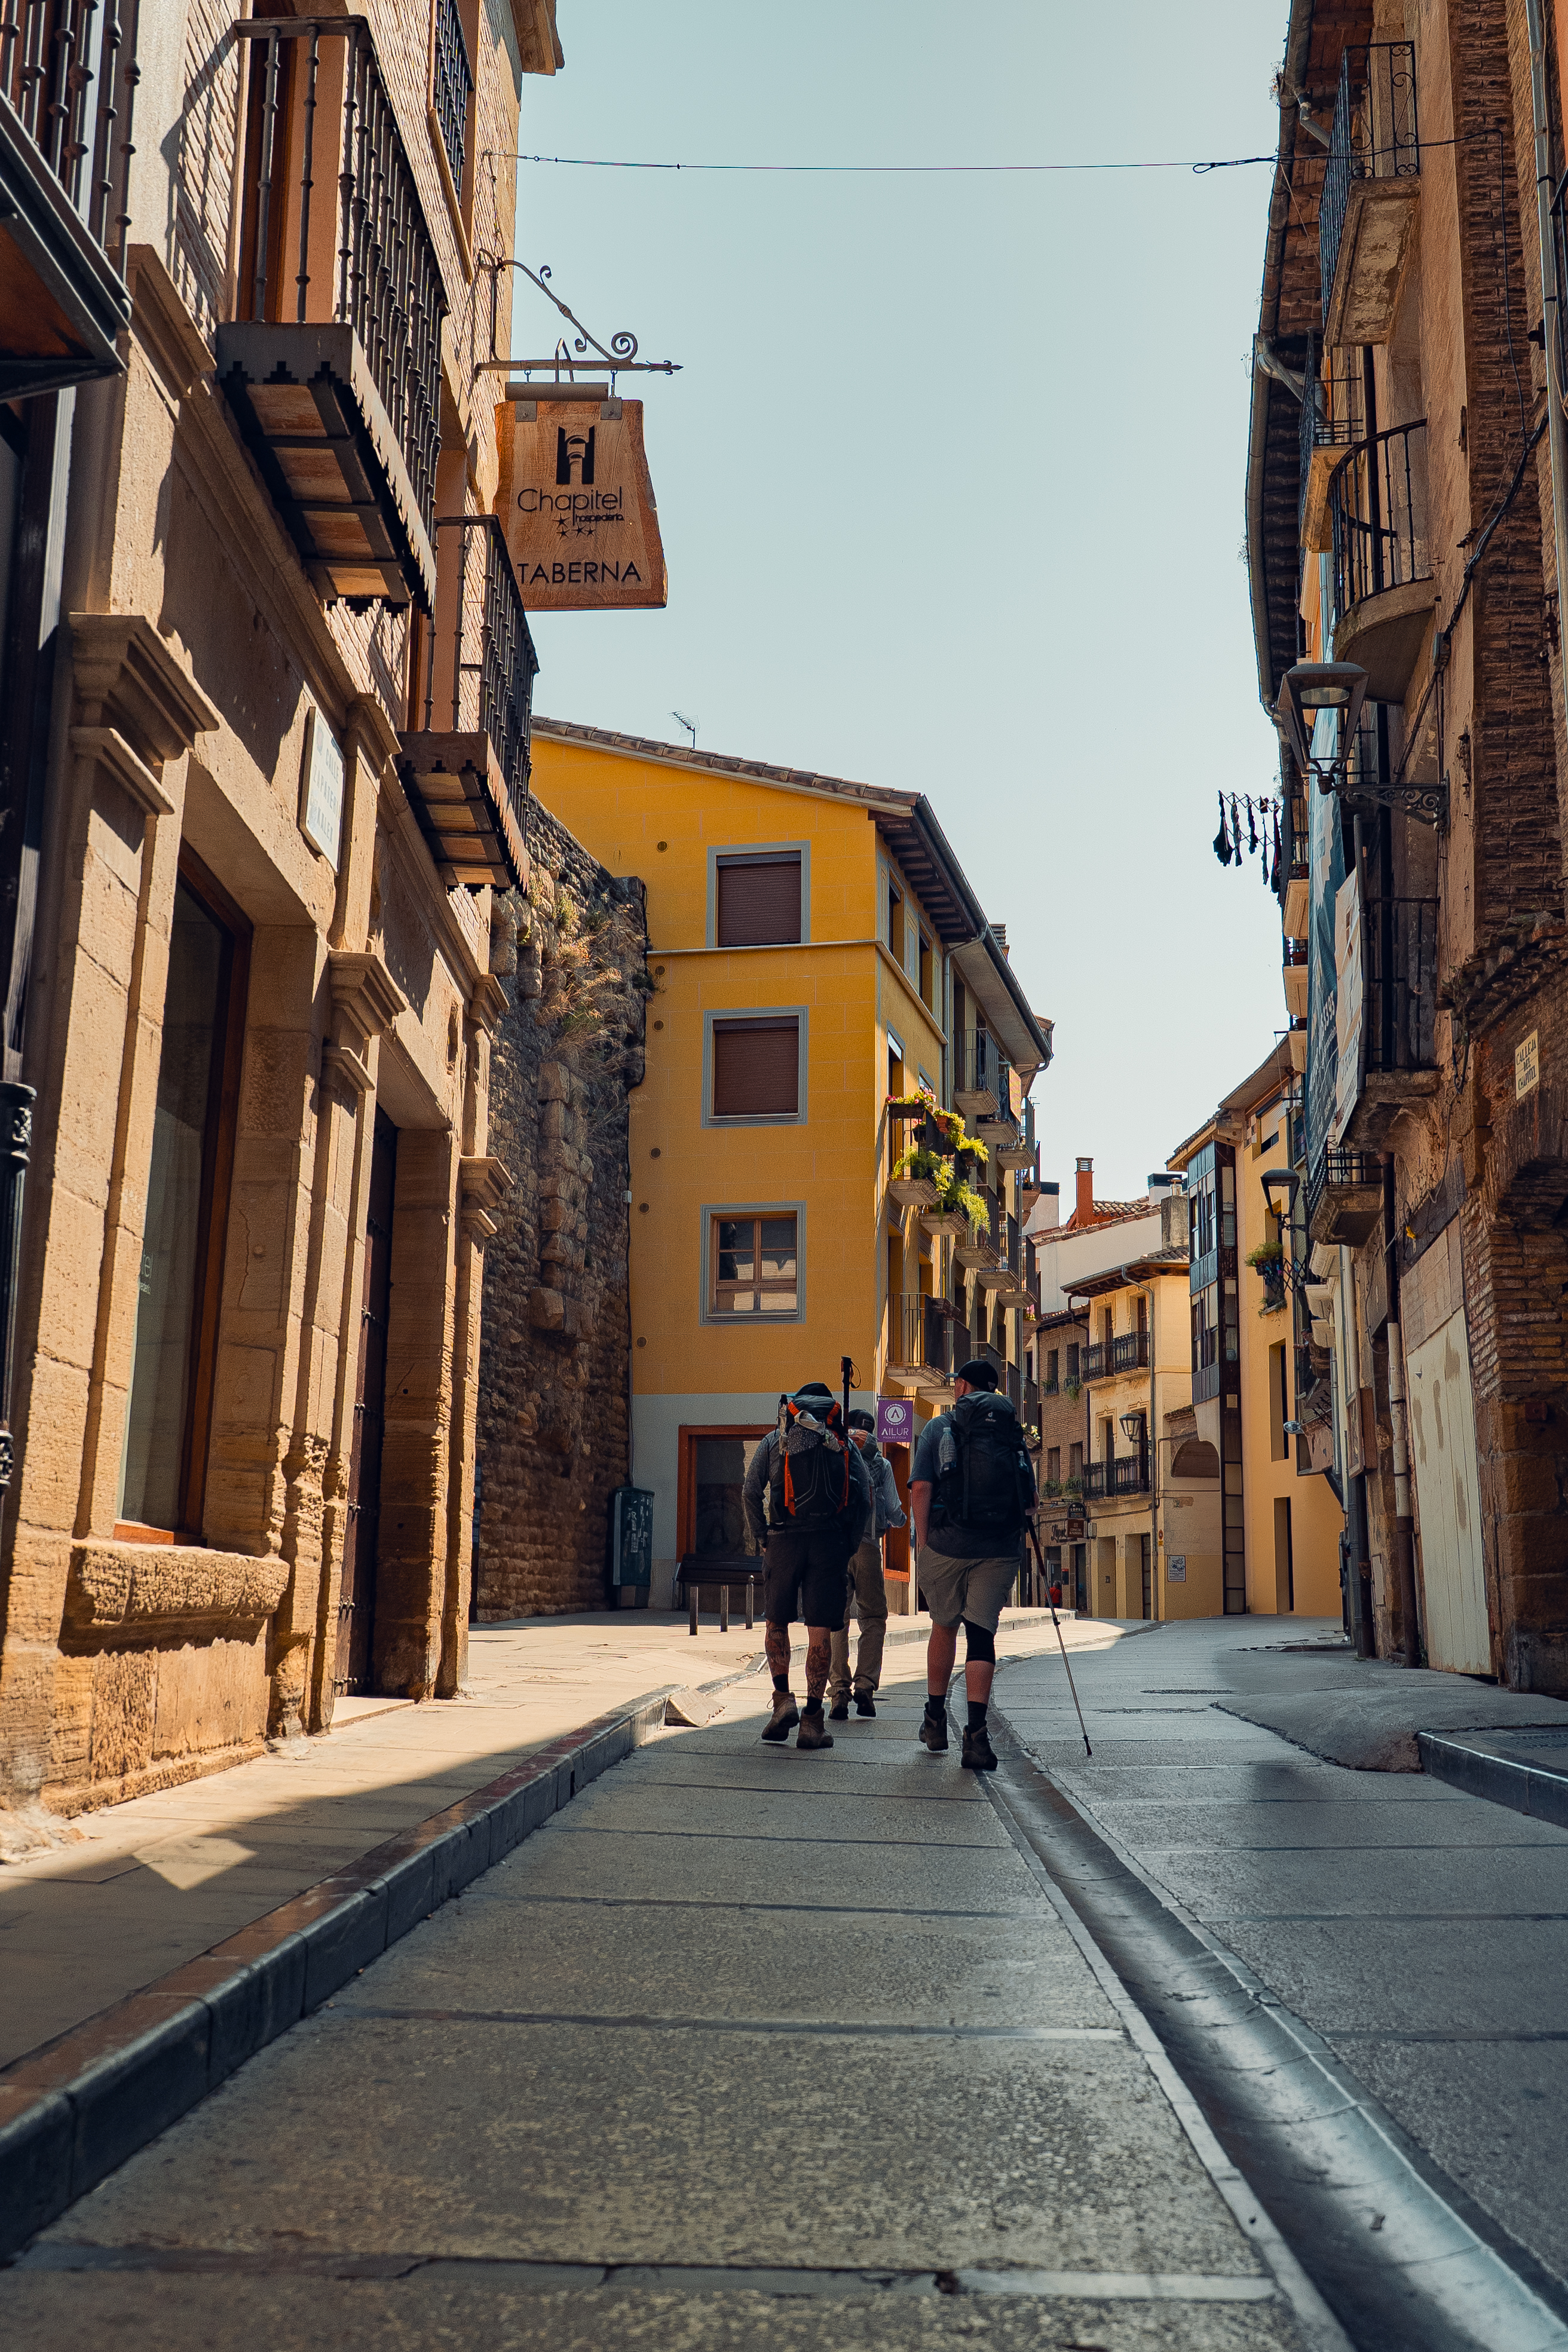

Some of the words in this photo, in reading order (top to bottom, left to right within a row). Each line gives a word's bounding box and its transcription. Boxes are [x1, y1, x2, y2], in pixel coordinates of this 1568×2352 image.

[517, 486, 623, 526] Chapitel
[516, 561, 642, 584] TABERNA
[325, 748, 339, 785] CALLE
[317, 806, 333, 845] KALEA
[1516, 1038, 1537, 1066] CALLEJA
[1523, 1056, 1532, 1072] DEL
[881, 1427, 909, 1436] AILUR
